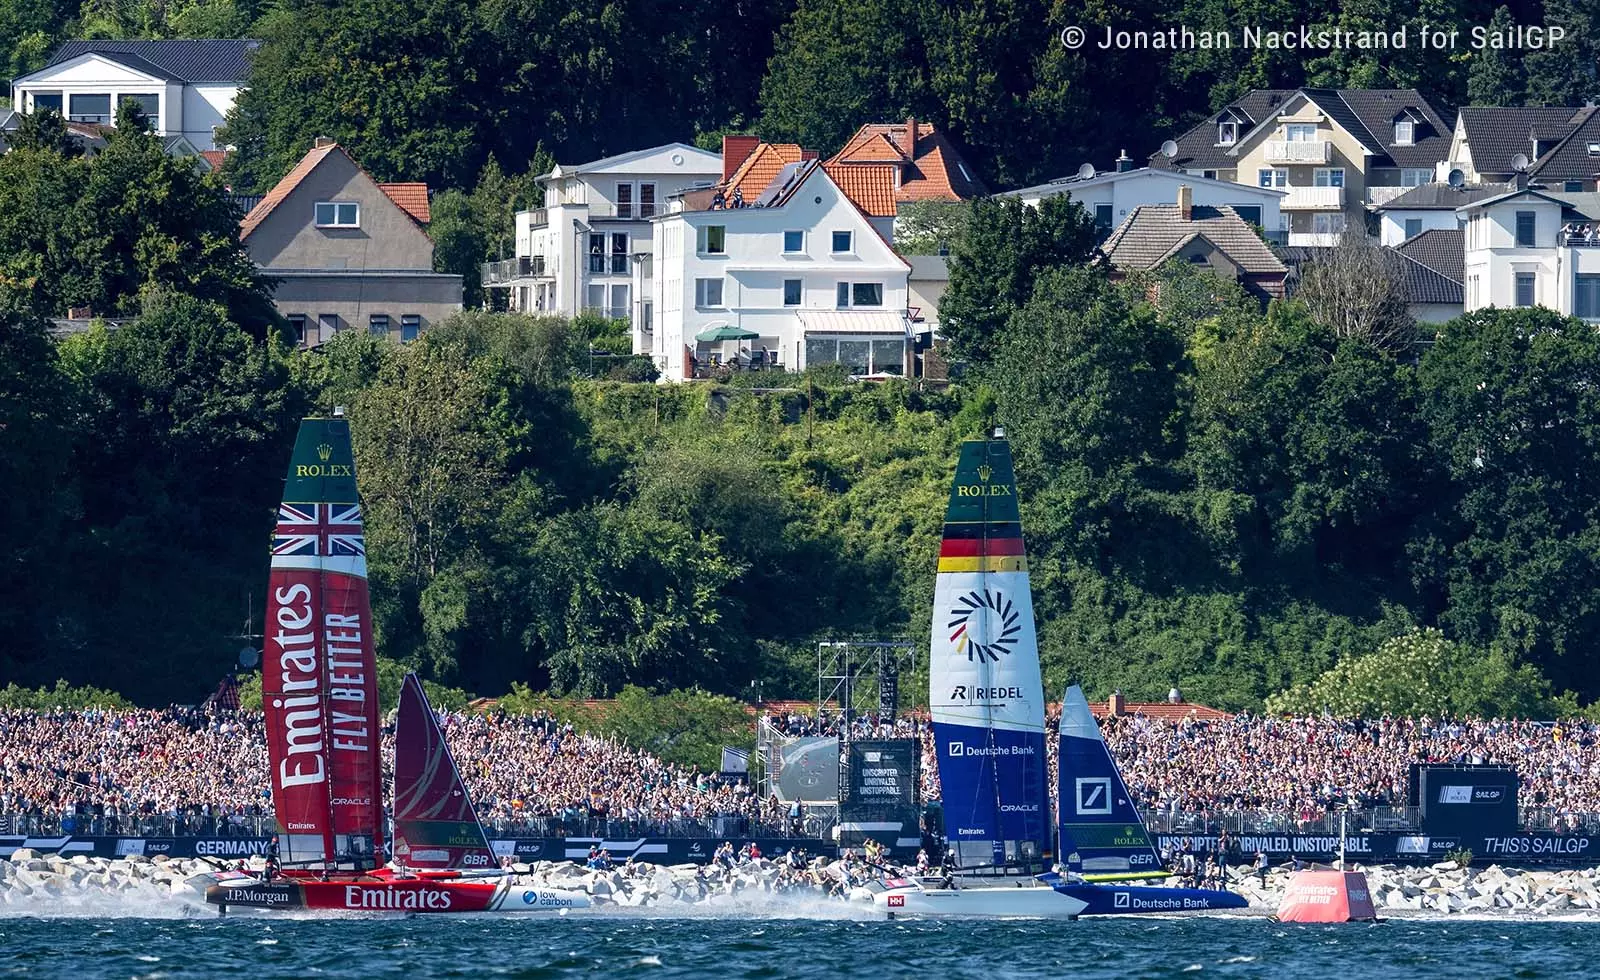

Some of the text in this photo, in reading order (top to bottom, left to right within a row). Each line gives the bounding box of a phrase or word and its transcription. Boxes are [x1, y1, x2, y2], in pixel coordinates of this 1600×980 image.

[296, 465, 351, 477] ROLEX
[957, 484, 1012, 497] ROLEX
[272, 583, 326, 789] Emirates
[325, 613, 368, 752] FLY BETTER
[976, 687, 1024, 700] RIEDEL
[966, 745, 1035, 756] Deutsche Bank
[1000, 804, 1038, 812] ORACLE
[287, 822, 316, 830] Emirates
[958, 827, 985, 836] Emirates
[449, 836, 478, 845] ROLEX
[1114, 837, 1144, 845] ROLEX
[1531, 837, 1589, 853] SAILGP
[195, 840, 268, 855] GERMANY
[463, 854, 489, 866] GBR
[1129, 854, 1154, 865] GER
[345, 885, 451, 909] Emirates
[540, 890, 556, 899] low
[540, 898, 572, 906] carbon
[1133, 898, 1209, 908] Deutsche Bank
